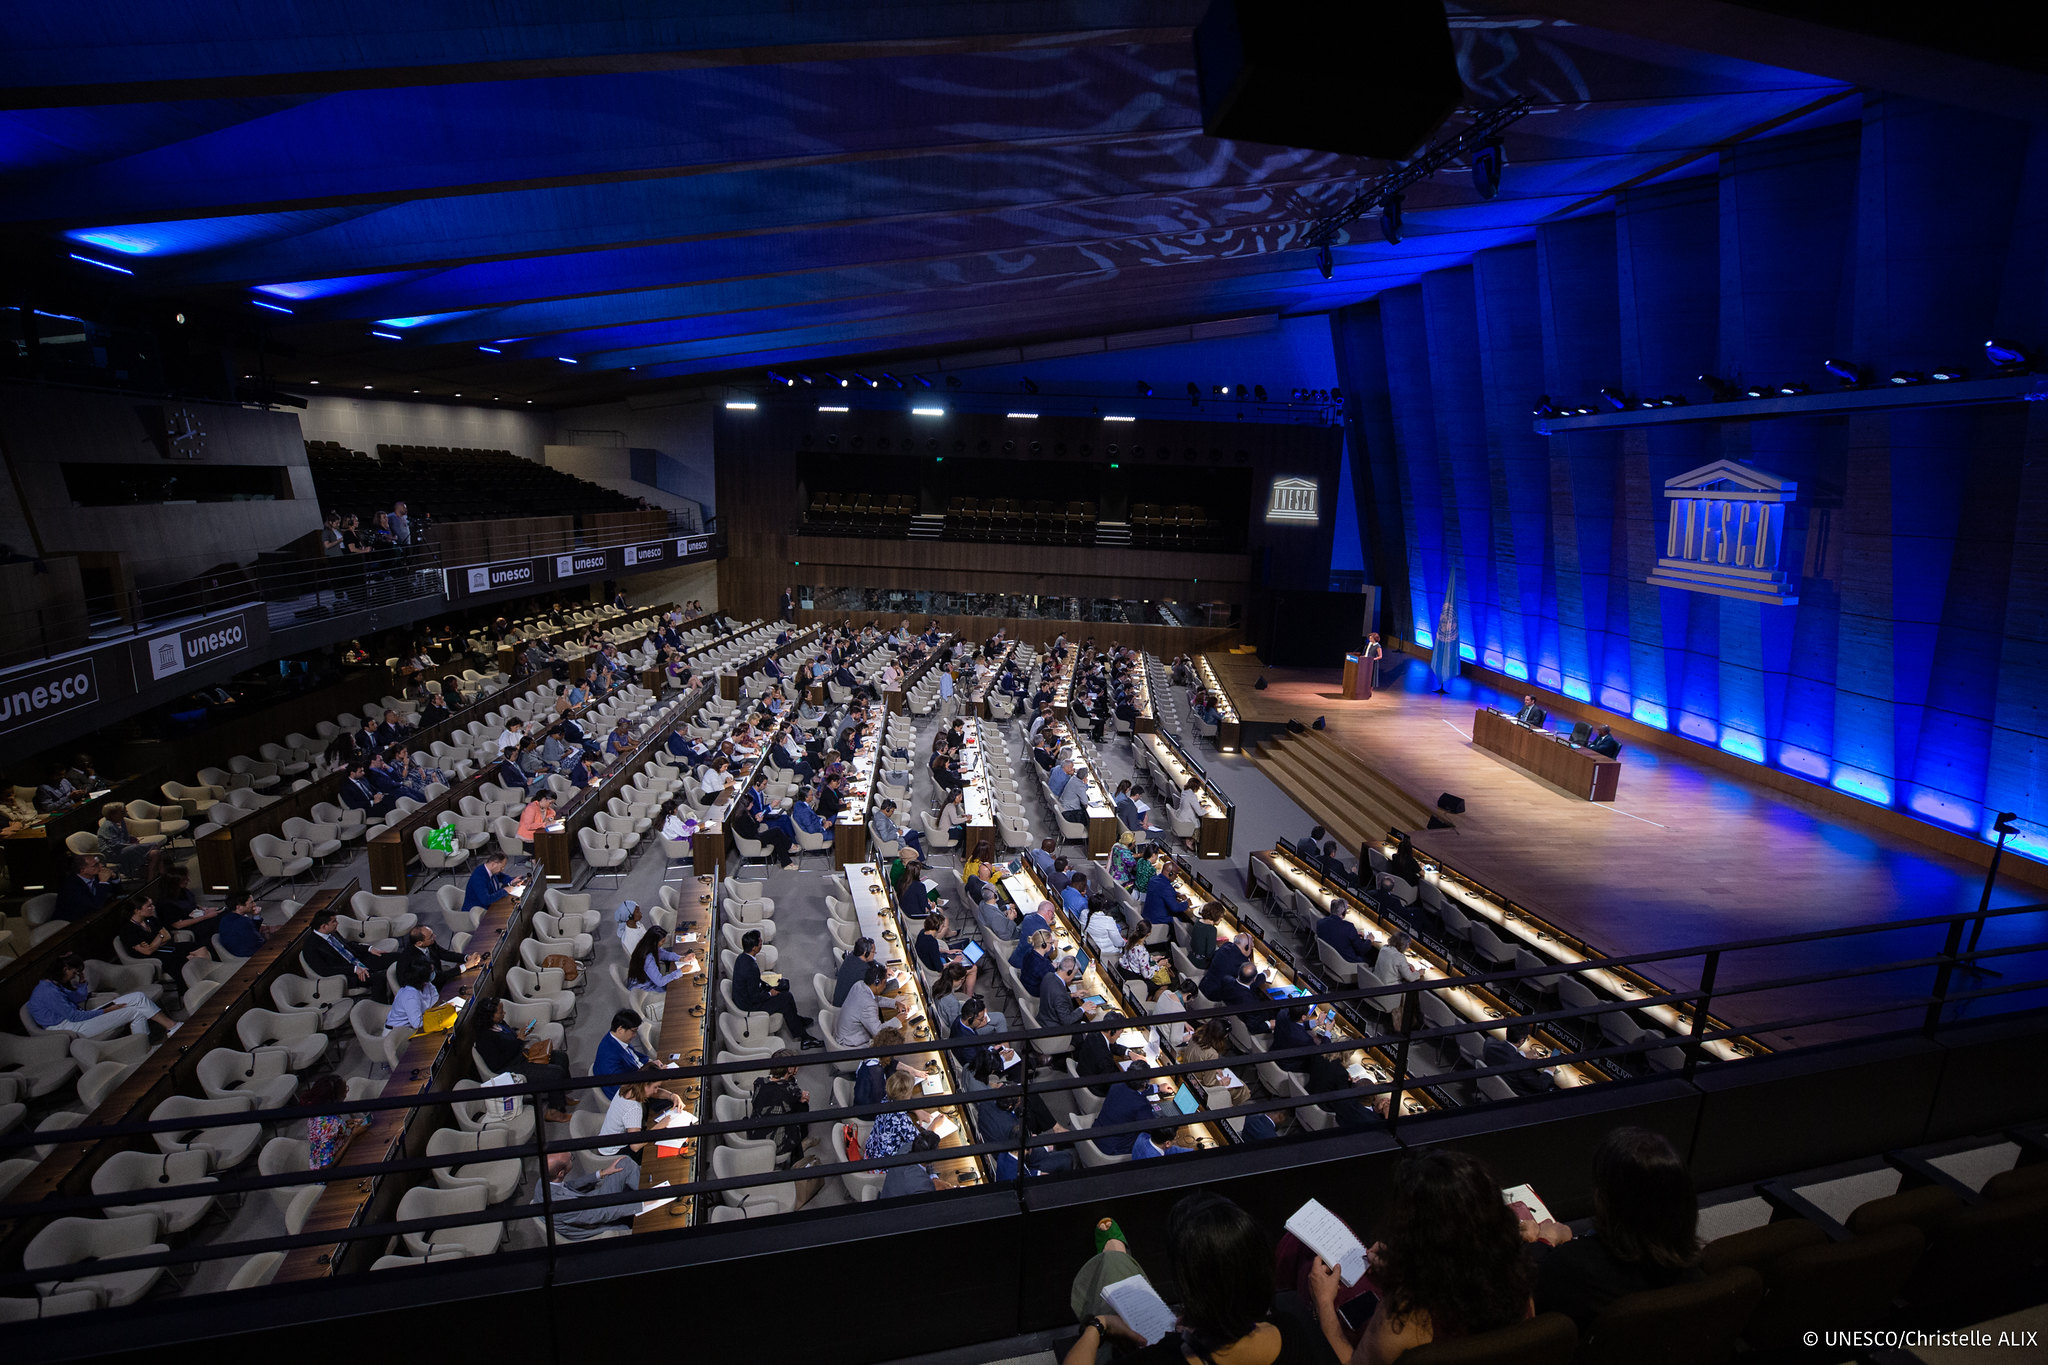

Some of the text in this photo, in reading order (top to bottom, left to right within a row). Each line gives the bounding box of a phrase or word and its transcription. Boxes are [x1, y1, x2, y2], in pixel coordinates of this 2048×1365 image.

[1273, 489, 1315, 511] UNESCO
[1667, 499, 1770, 569] UNESCO
[637, 546, 662, 560] unesco
[687, 537, 708, 551] unesco
[574, 556, 604, 570] unesco
[491, 567, 531, 584] unesco
[187, 625, 243, 658] unesco
[1547, 1023, 1579, 1049] BHOUTAN
